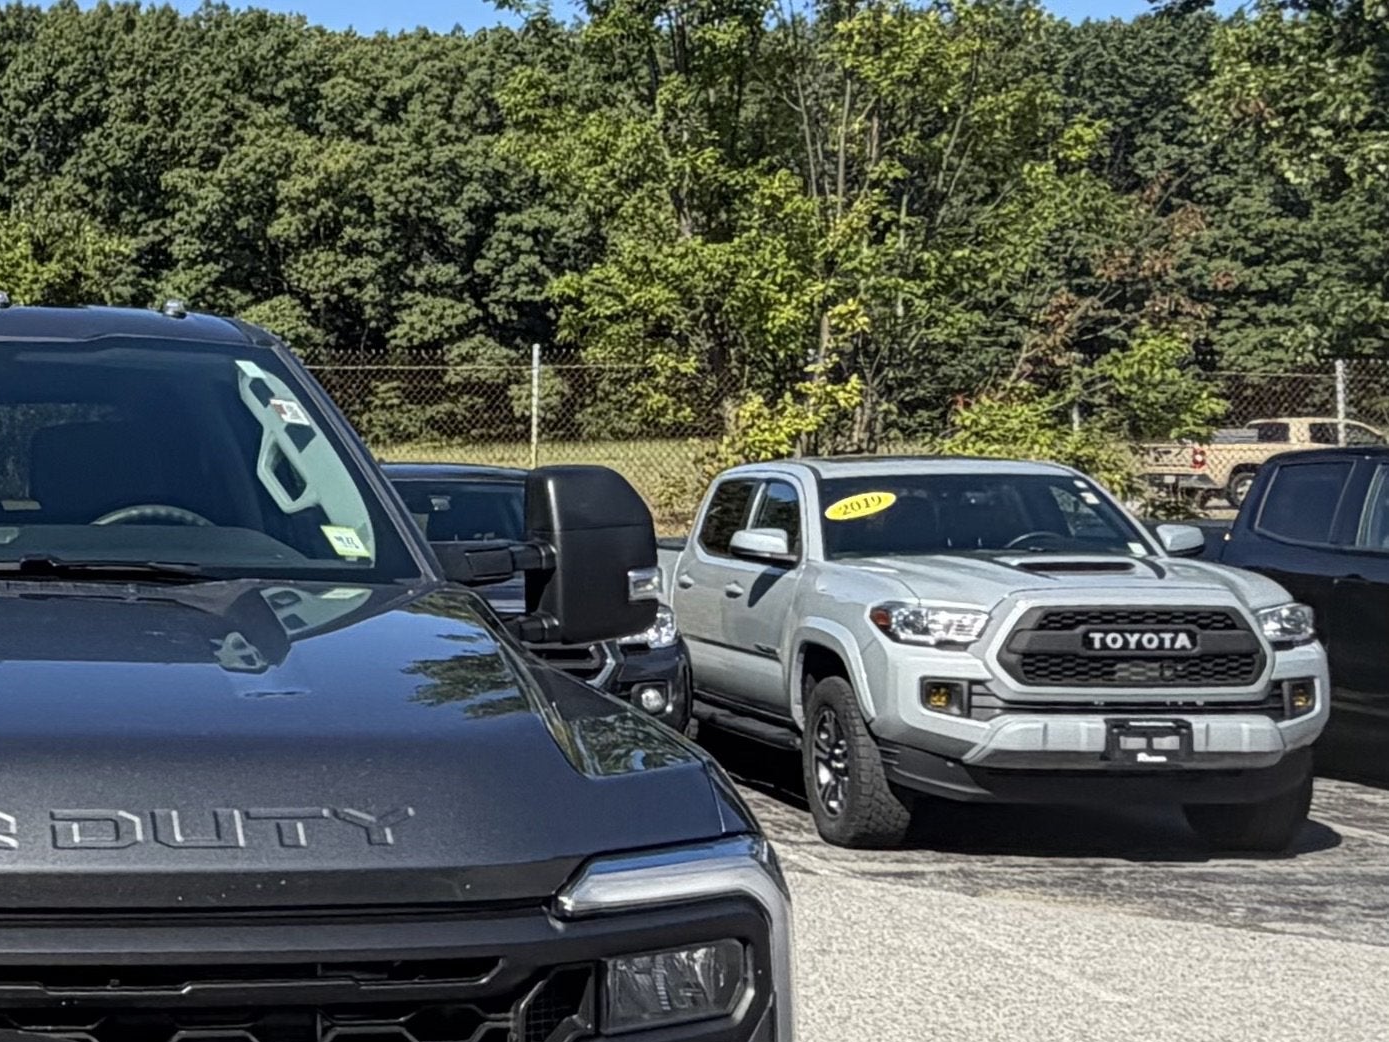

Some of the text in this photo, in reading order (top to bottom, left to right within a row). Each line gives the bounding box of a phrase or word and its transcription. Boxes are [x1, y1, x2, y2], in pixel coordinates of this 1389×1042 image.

[838, 495, 882, 516] 2019
[1088, 632, 1193, 650] TOYOTA
[49, 806, 416, 850] DUTY
